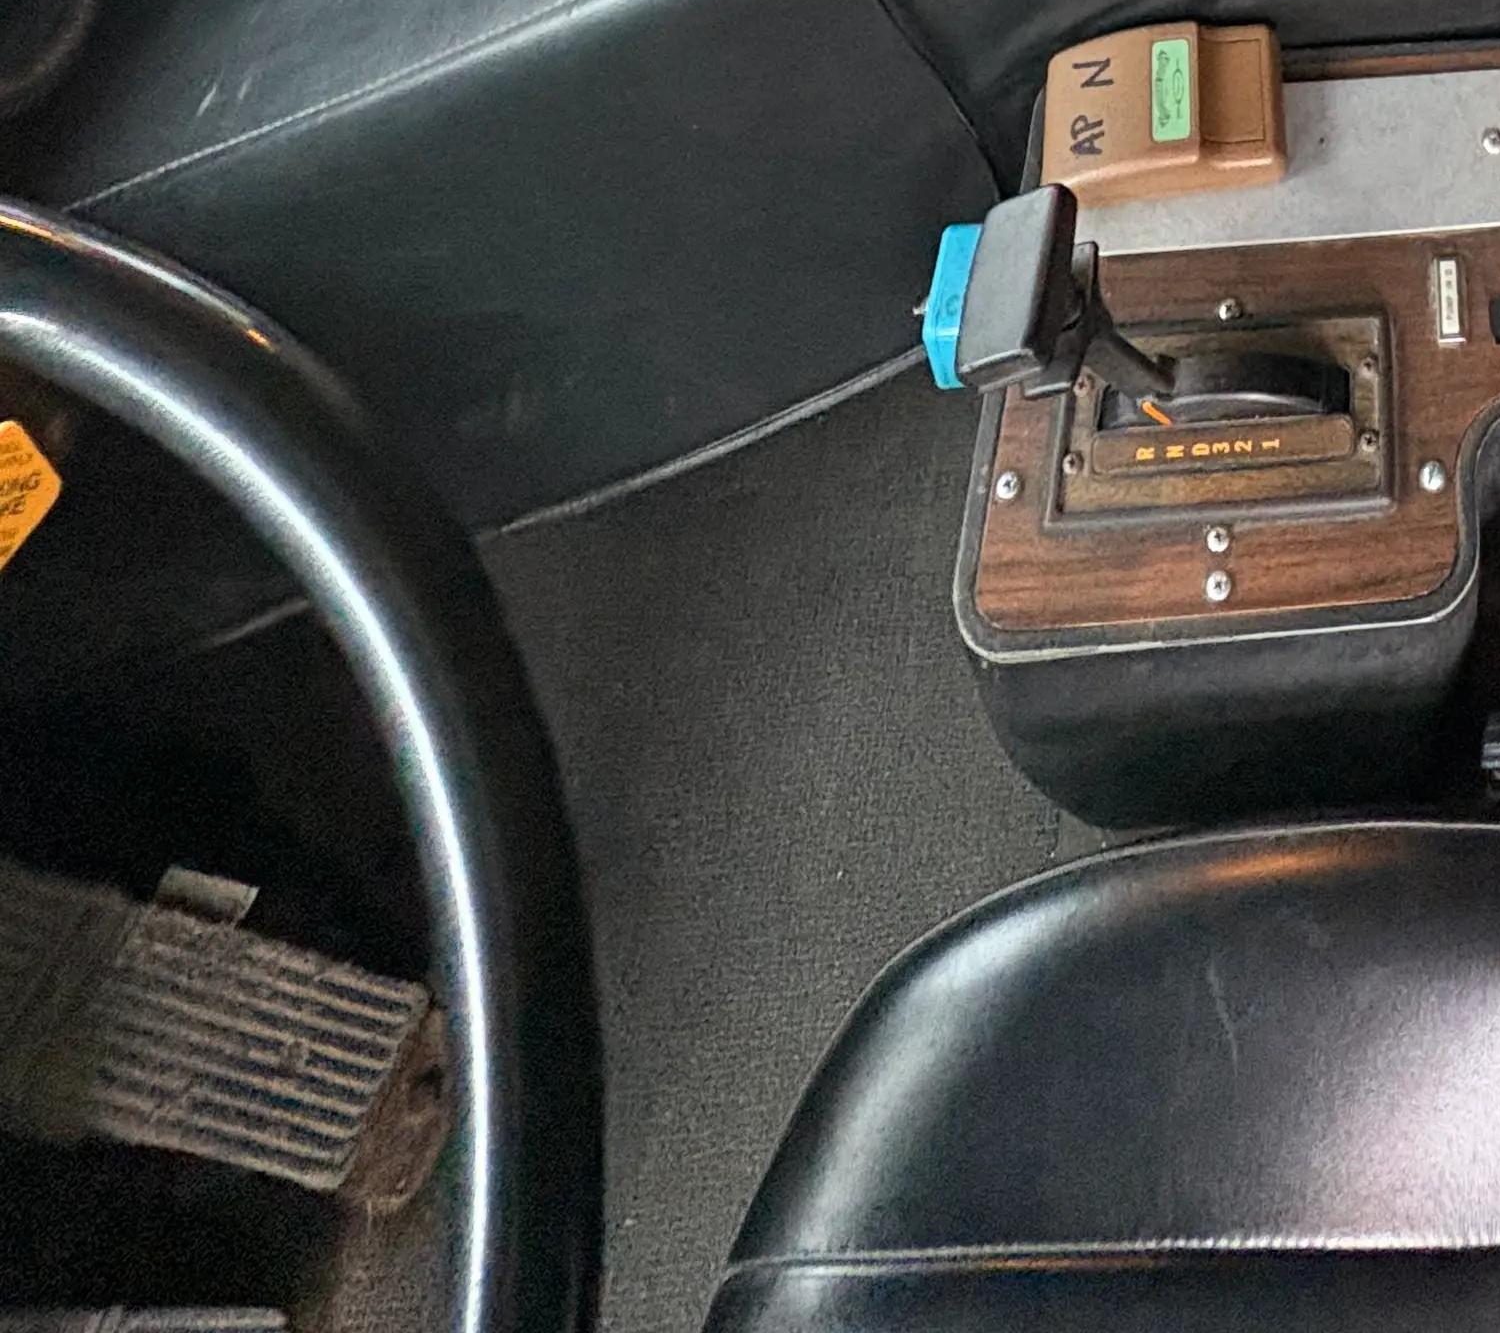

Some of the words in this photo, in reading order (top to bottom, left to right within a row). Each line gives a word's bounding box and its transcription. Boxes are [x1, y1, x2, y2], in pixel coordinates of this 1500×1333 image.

[1072, 57, 1114, 88] N
[1070, 114, 1105, 155] AP
[1135, 446, 1156, 461] R
[1191, 442, 1210, 457] D
[1212, 441, 1230, 454] 3
[1234, 439, 1253, 453] 2
[1261, 438, 1281, 450] 1
